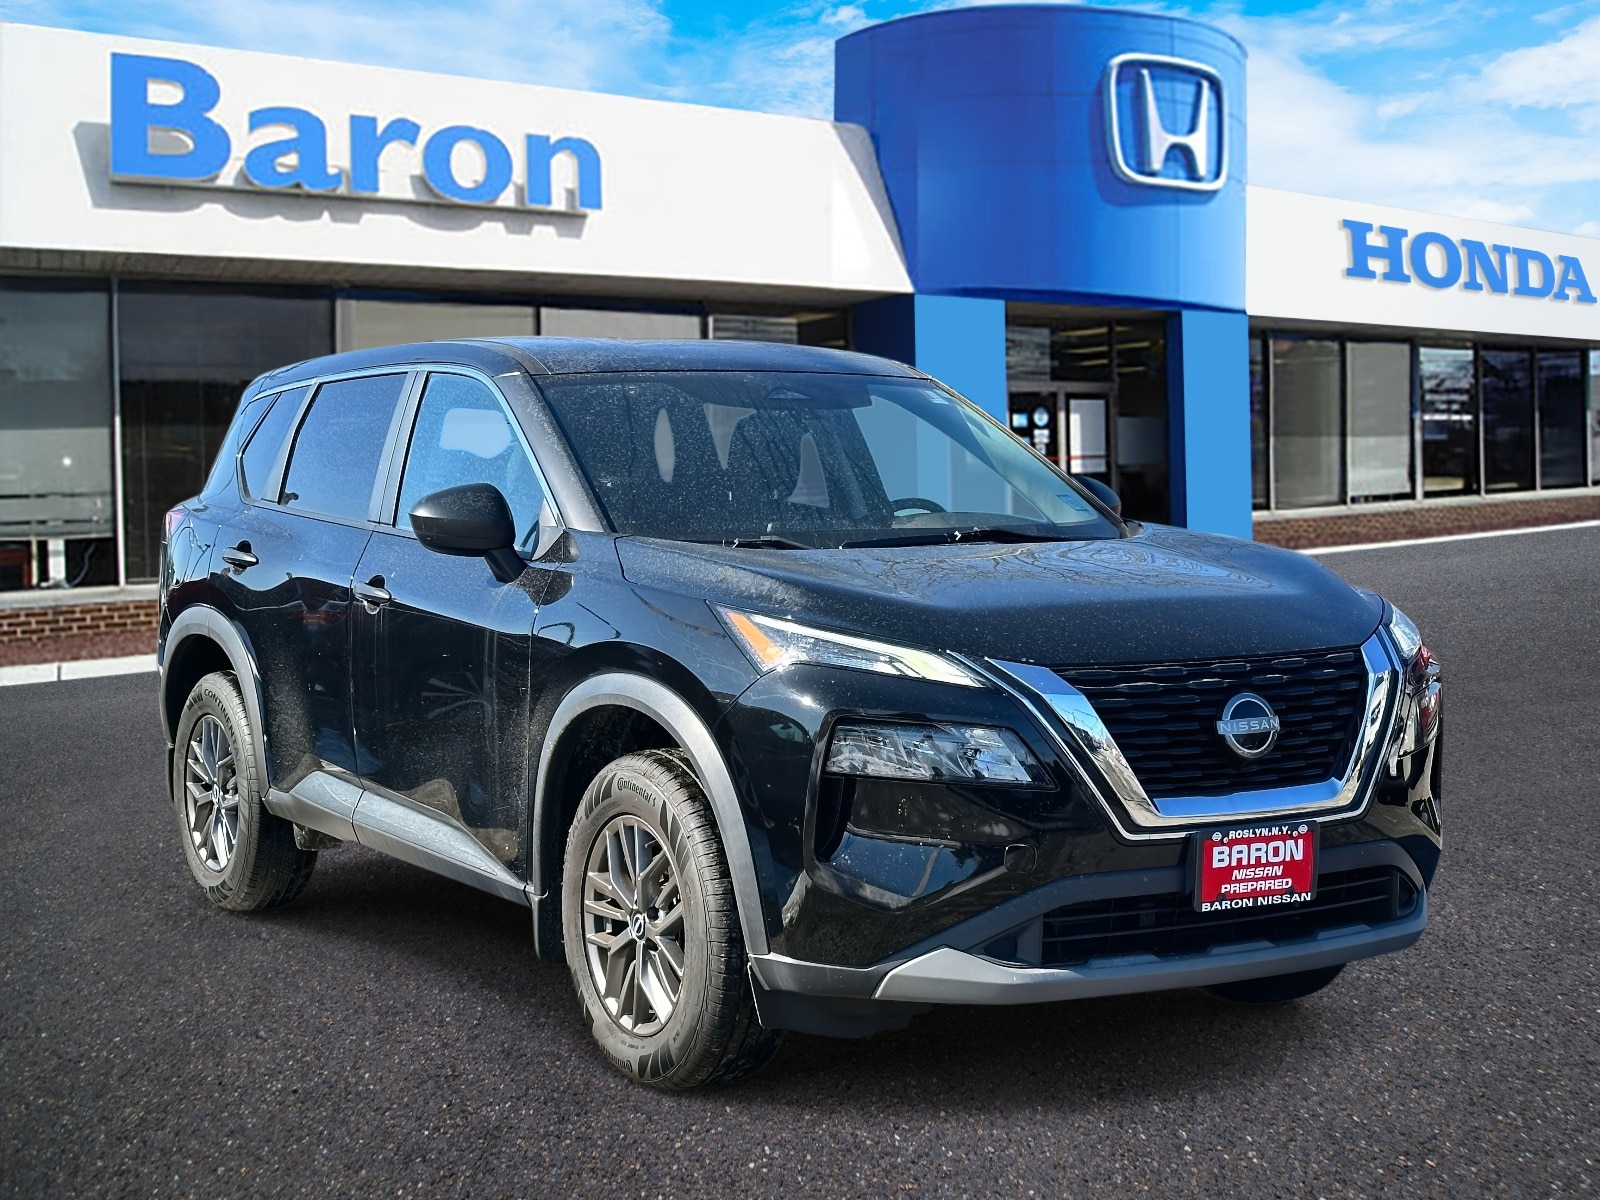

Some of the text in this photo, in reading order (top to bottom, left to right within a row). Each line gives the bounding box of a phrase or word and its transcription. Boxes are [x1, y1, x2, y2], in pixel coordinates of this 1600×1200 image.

[109, 52, 602, 210] Baron
[1342, 218, 1598, 304] HONDA
[1219, 719, 1279, 733] NISSAN
[617, 777, 653, 804] Continental
[1212, 838, 1304, 869] BARON
[1231, 865, 1284, 880] NISSAN
[1220, 878, 1292, 894] PREPARED
[1201, 892, 1311, 912] BARON NISSAN
